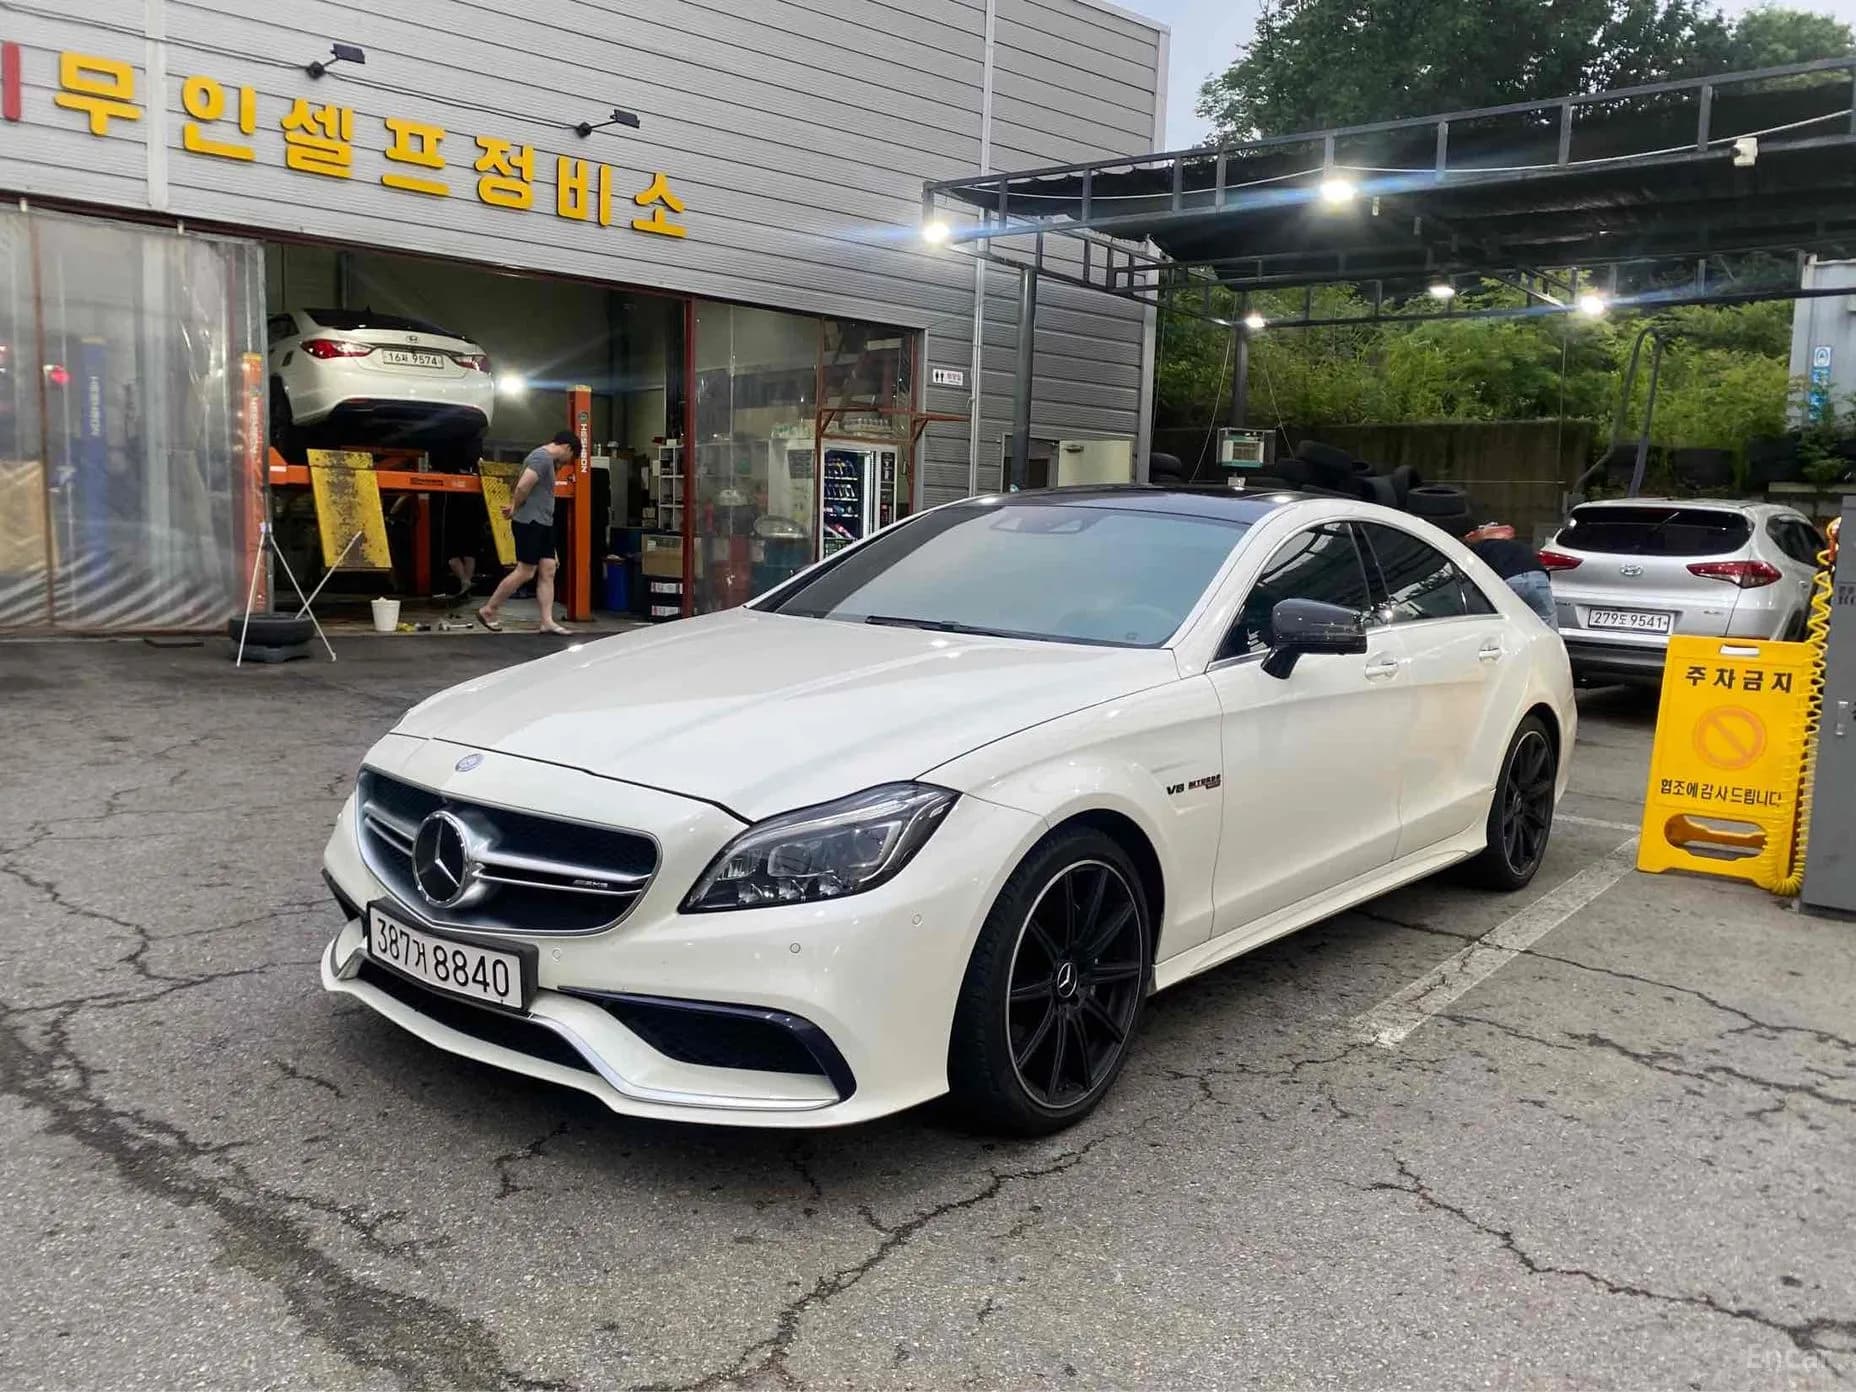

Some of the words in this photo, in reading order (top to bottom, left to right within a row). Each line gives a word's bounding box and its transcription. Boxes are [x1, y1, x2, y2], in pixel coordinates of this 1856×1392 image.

[412, 353, 438, 366] 9574
[1594, 612, 1628, 625] 279도
[1630, 614, 1662, 629] 9541
[1166, 783, 1185, 796] V8
[377, 918, 428, 974] 387거
[433, 945, 510, 997] 8840
